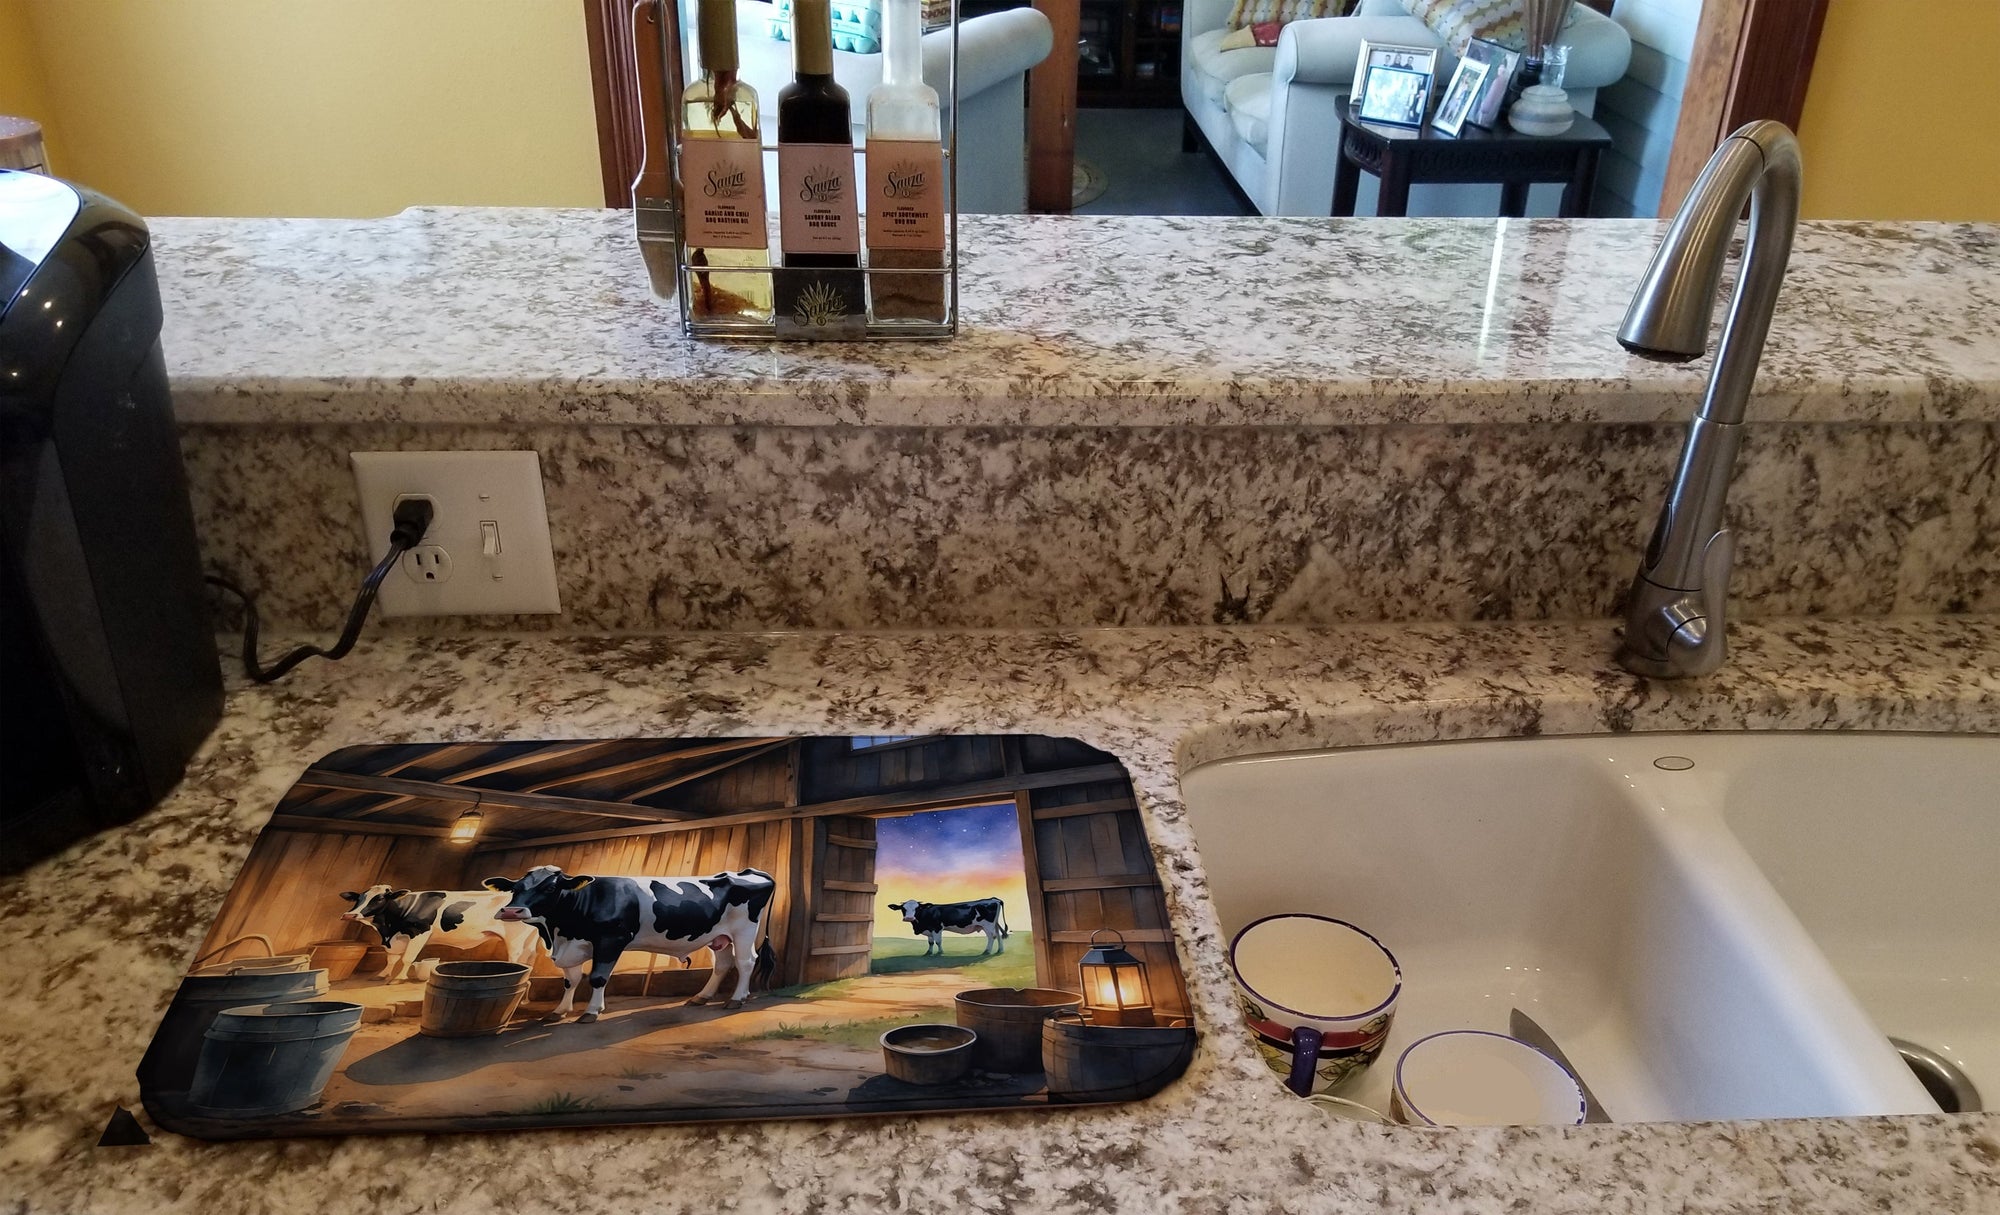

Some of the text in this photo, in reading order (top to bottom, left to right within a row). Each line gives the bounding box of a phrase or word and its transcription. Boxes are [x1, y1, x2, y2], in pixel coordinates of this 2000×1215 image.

[703, 170, 746, 198] Sauza
[799, 175, 842, 202] Sauza
[883, 171, 926, 198] Sauza
